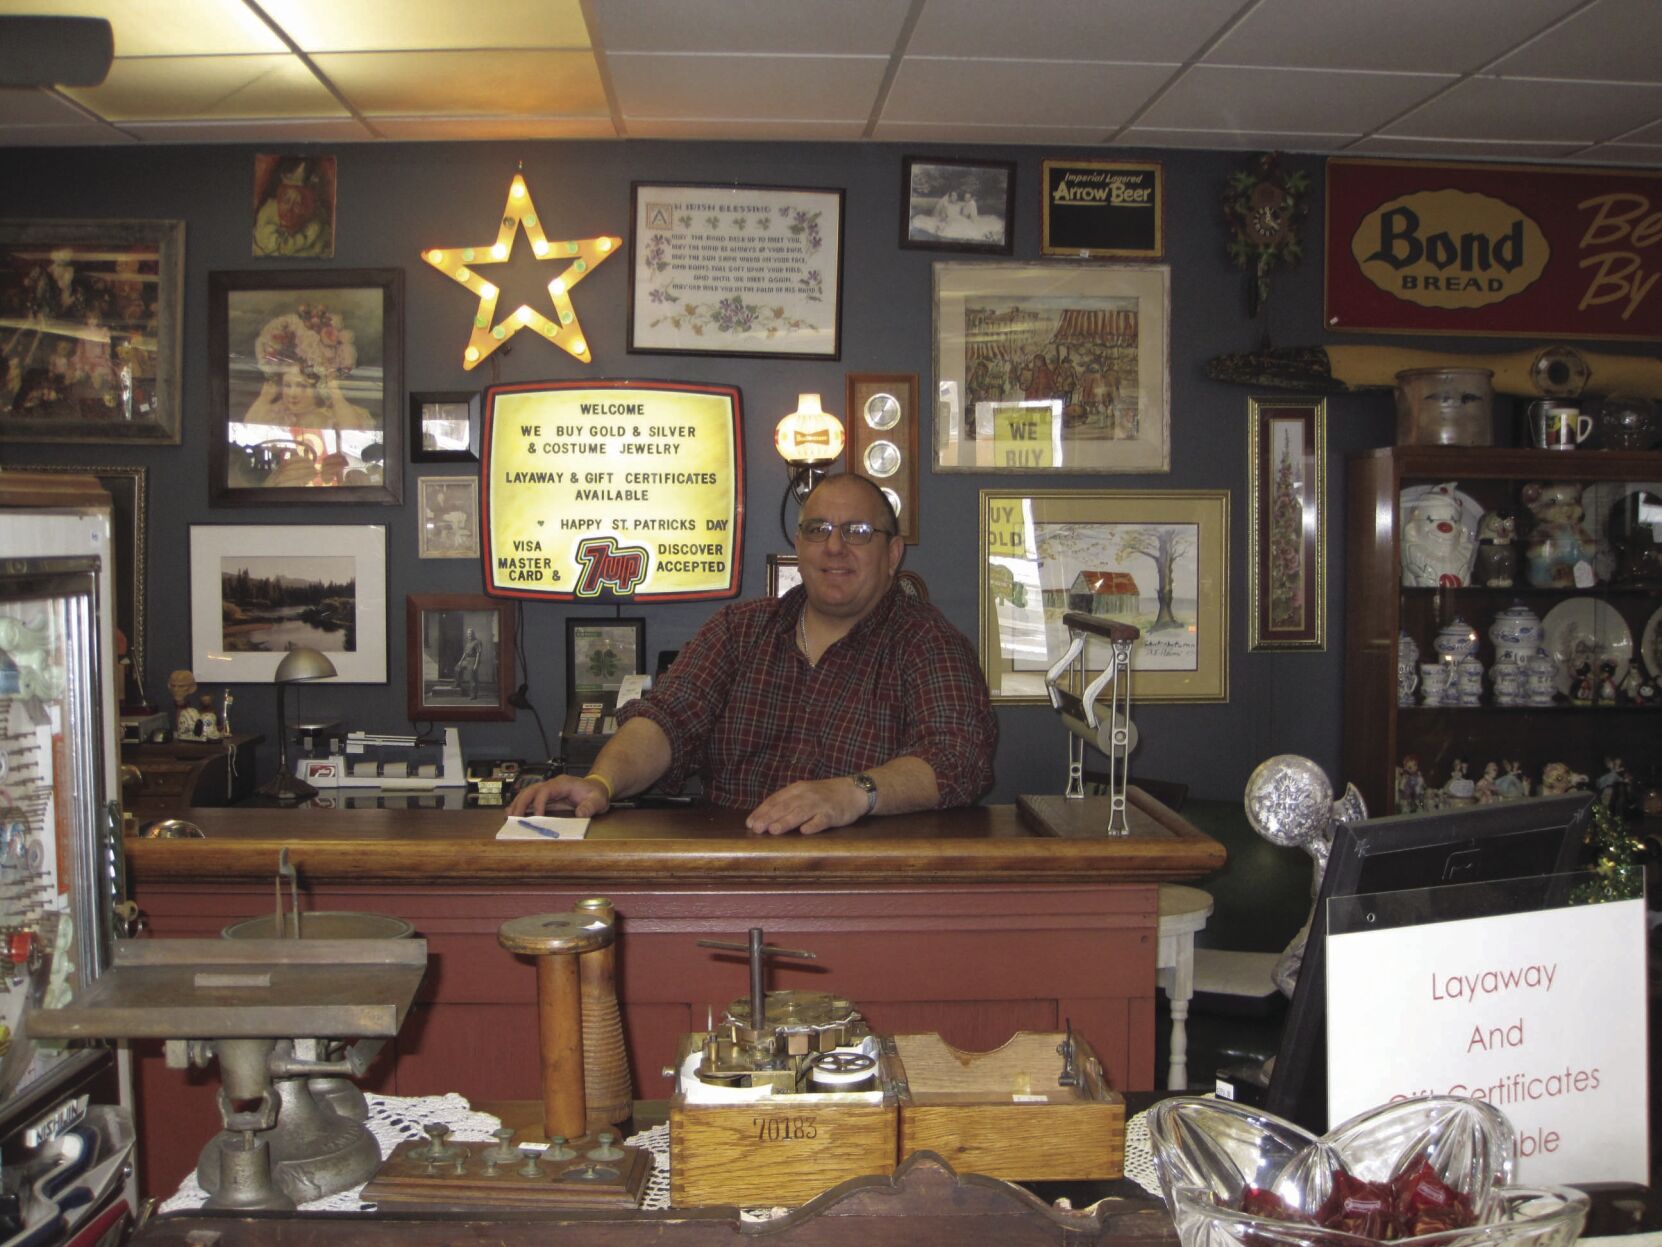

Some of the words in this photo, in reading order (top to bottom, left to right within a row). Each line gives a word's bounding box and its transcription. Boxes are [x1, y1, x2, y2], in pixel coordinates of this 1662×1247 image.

[1065, 172, 1105, 183] Imperial
[1053, 181, 1108, 200] Arrow
[1110, 182, 1151, 202] Beer
[1363, 206, 1523, 273] Bond
[1401, 275, 1504, 292] BREAD
[1577, 251, 1661, 320] By
[581, 404, 644, 415] WELCOME
[521, 426, 541, 436] WE
[556, 426, 583, 437] BUY
[589, 426, 626, 437] GOLD
[632, 426, 641, 437] &
[648, 426, 696, 438] SILVER
[1009, 422, 1038, 440] WE
[528, 443, 537, 454] &
[543, 443, 607, 454] COSTUME
[619, 443, 680, 454] JEWELRY
[1006, 450, 1044, 467] BUY
[505, 472, 564, 484] LAYAWAY
[570, 473, 579, 484] &
[585, 473, 614, 484] GIFT
[625, 473, 717, 485] CERTIFICATES
[575, 490, 649, 501] AVAILABLE
[561, 519, 602, 531] HAPPY
[612, 519, 628, 531] ST.
[634, 519, 696, 531] PATRICKS
[706, 519, 729, 531] DAY
[513, 541, 542, 552] VISA
[658, 544, 723, 556] DISCOVER
[498, 558, 552, 569] MASTER
[656, 561, 726, 573] ACCEPTED
[509, 570, 544, 581] CARD
[552, 570, 561, 581] &
[1432, 963, 1557, 1002] Layaway
[1467, 1017, 1524, 1053] And
[753, 1117, 818, 1141] 70183
